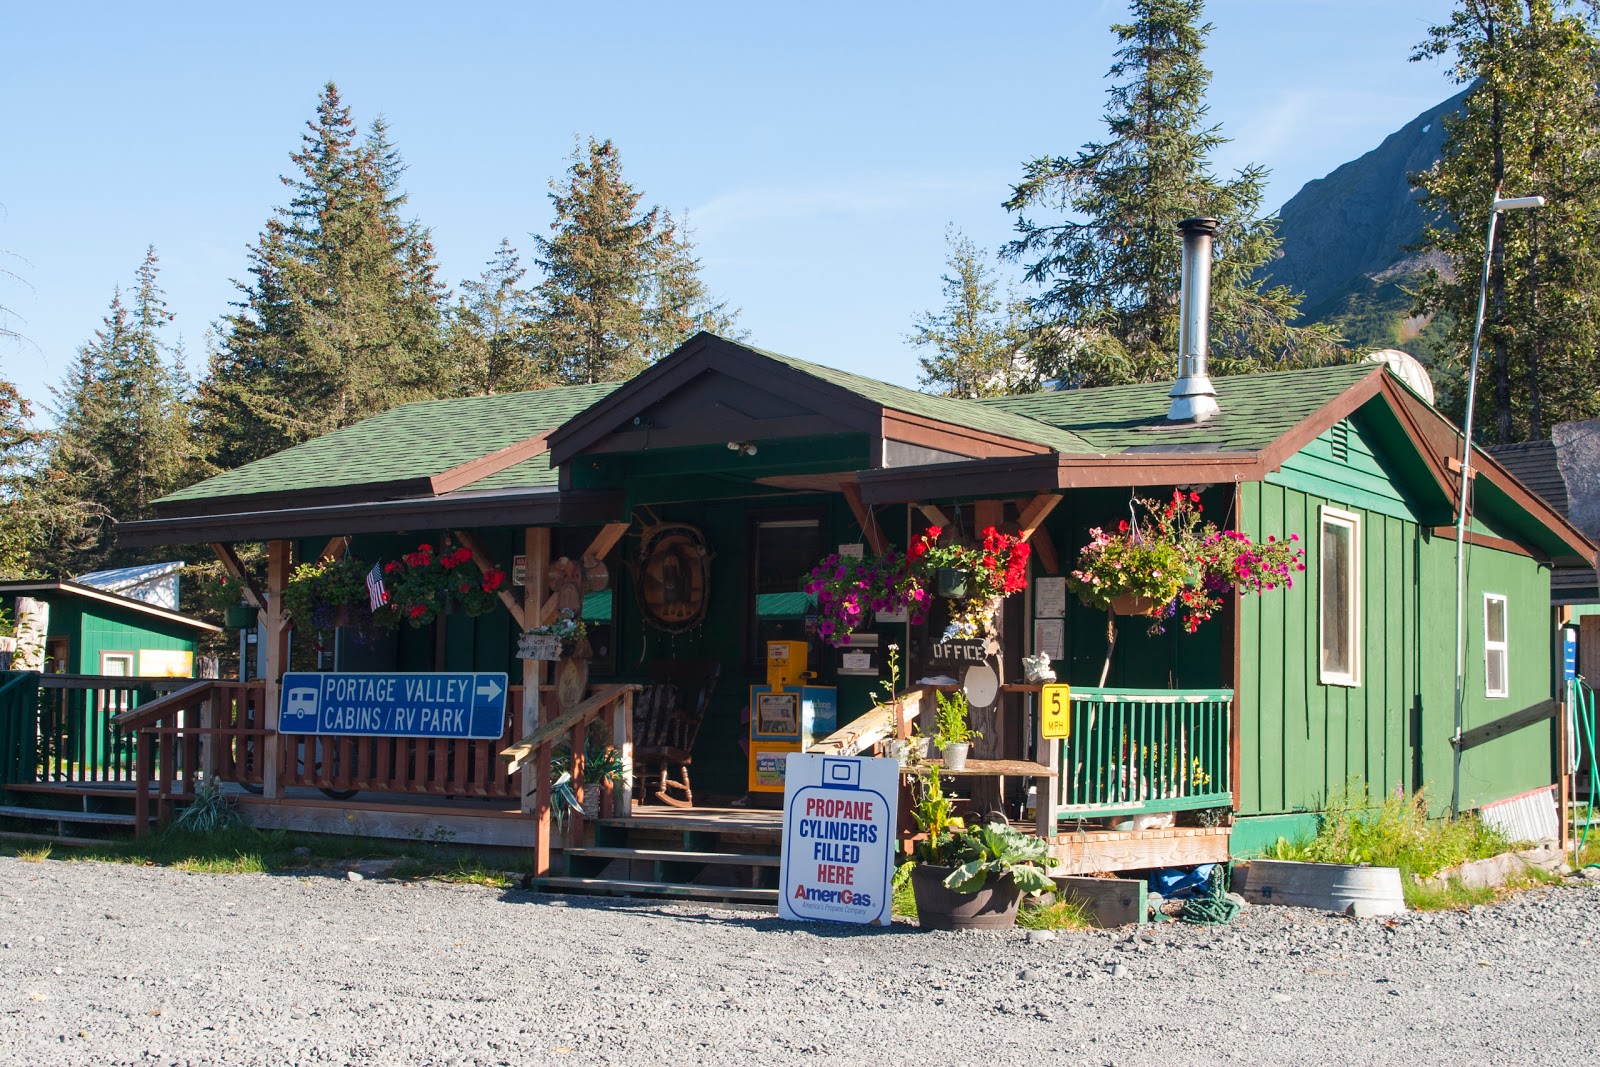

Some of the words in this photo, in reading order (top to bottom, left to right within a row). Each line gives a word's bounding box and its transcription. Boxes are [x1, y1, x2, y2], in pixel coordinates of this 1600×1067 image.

[933, 643, 984, 661] OFFICE
[326, 679, 396, 702] PORTAGE
[406, 679, 469, 703] VALLEY
[1051, 692, 1061, 716] 5
[420, 708, 465, 732] PARK
[1048, 721, 1064, 731] MPH
[806, 797, 873, 821] PROPANE
[799, 819, 878, 844] CYLINDERS
[813, 842, 860, 864] FILLED
[817, 864, 855, 886] HERE
[794, 884, 871, 907] AmeriGas
[801, 901, 824, 911] America's
[824, 903, 844, 913] Propane
[844, 905, 867, 915] Company
